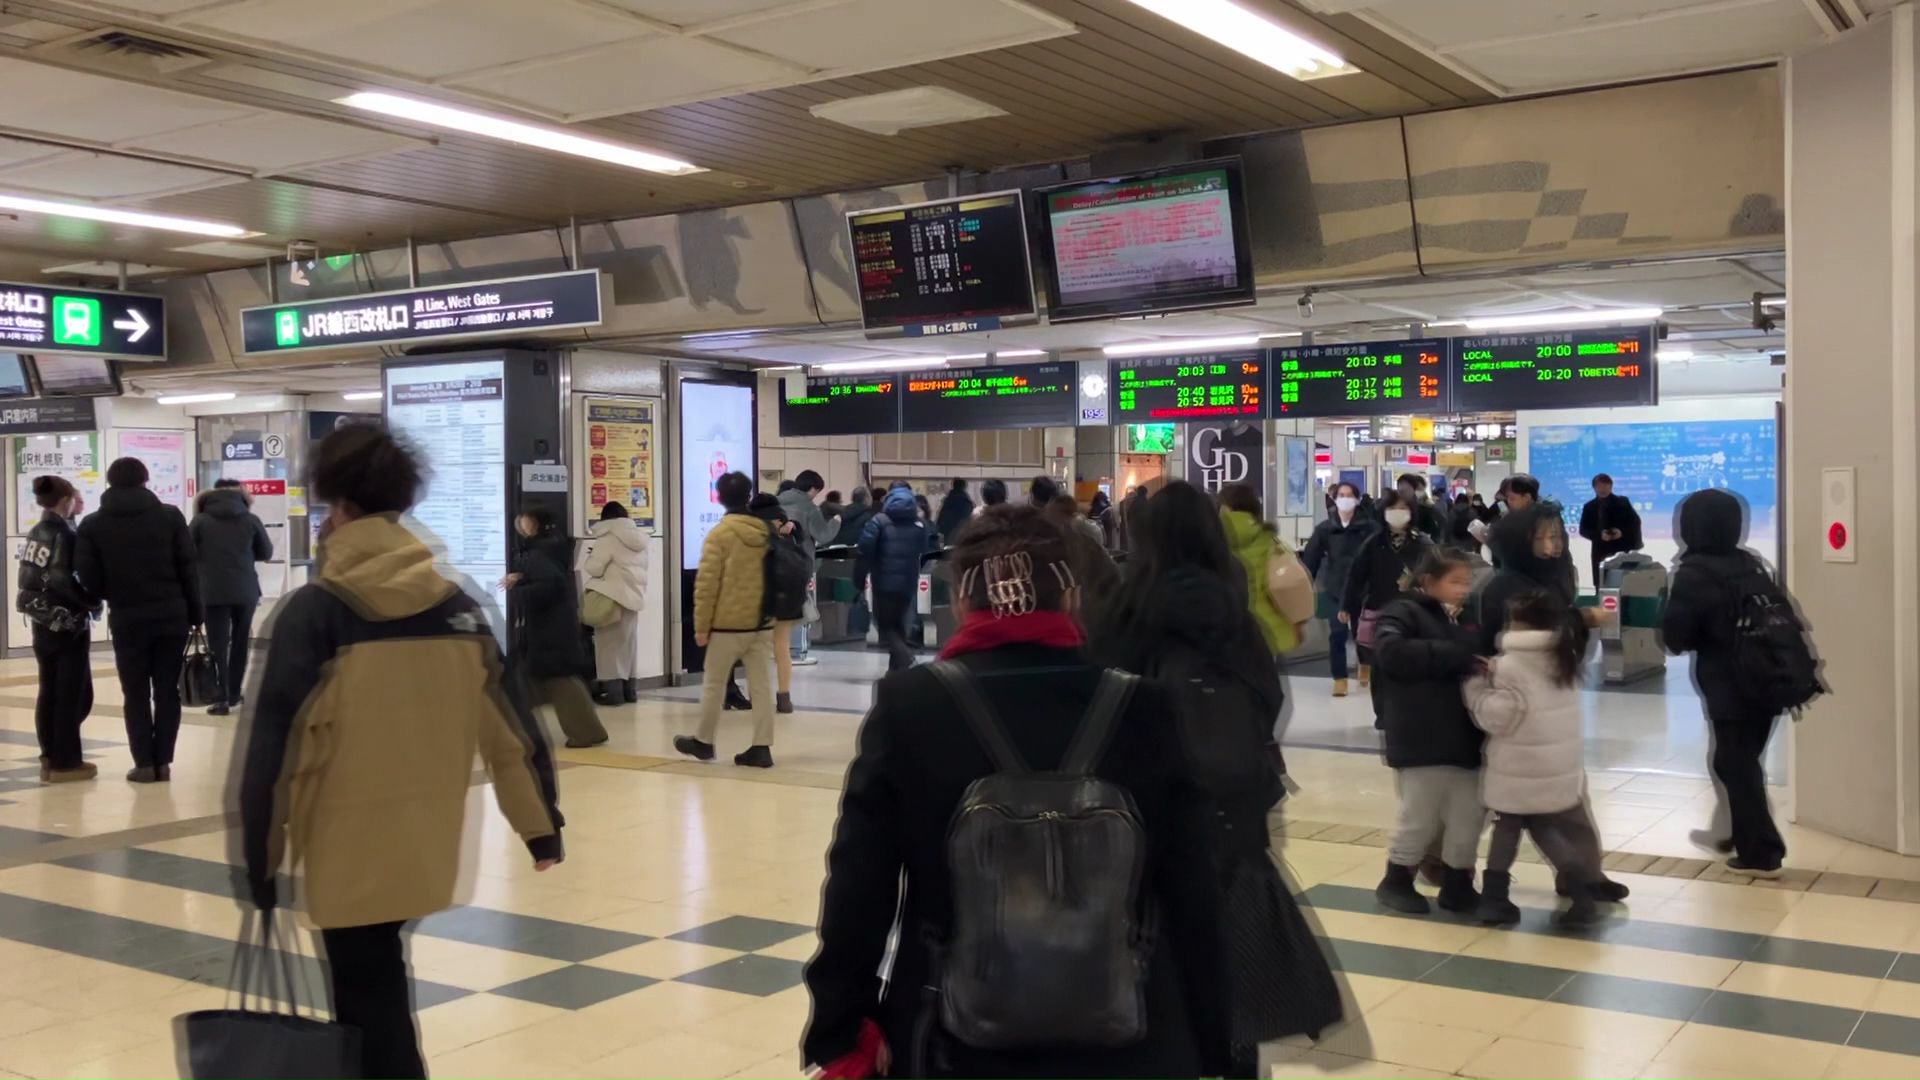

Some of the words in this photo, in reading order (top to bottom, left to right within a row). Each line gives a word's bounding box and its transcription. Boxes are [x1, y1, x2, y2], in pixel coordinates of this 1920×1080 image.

[413, 299, 424, 313] JR
[473, 292, 500, 306] Gates
[15, 316, 45, 328] Gates
[302, 305, 409, 338] JR線西改札口
[1463, 351, 1493, 361] LOCAL
[1536, 345, 1571, 359] 20:00
[1346, 356, 1377, 368] 20:03
[1177, 365, 1205, 377] 20:03
[1463, 372, 1493, 383] LOCAL
[1536, 368, 1571, 381] 20:20
[1346, 377, 1377, 389] 20:17
[1177, 386, 1205, 397] 20:40
[1346, 389, 1377, 400] 20:25
[1177, 396, 1205, 408] 20:52
[22, 453, 63, 467] JR札幌駅
